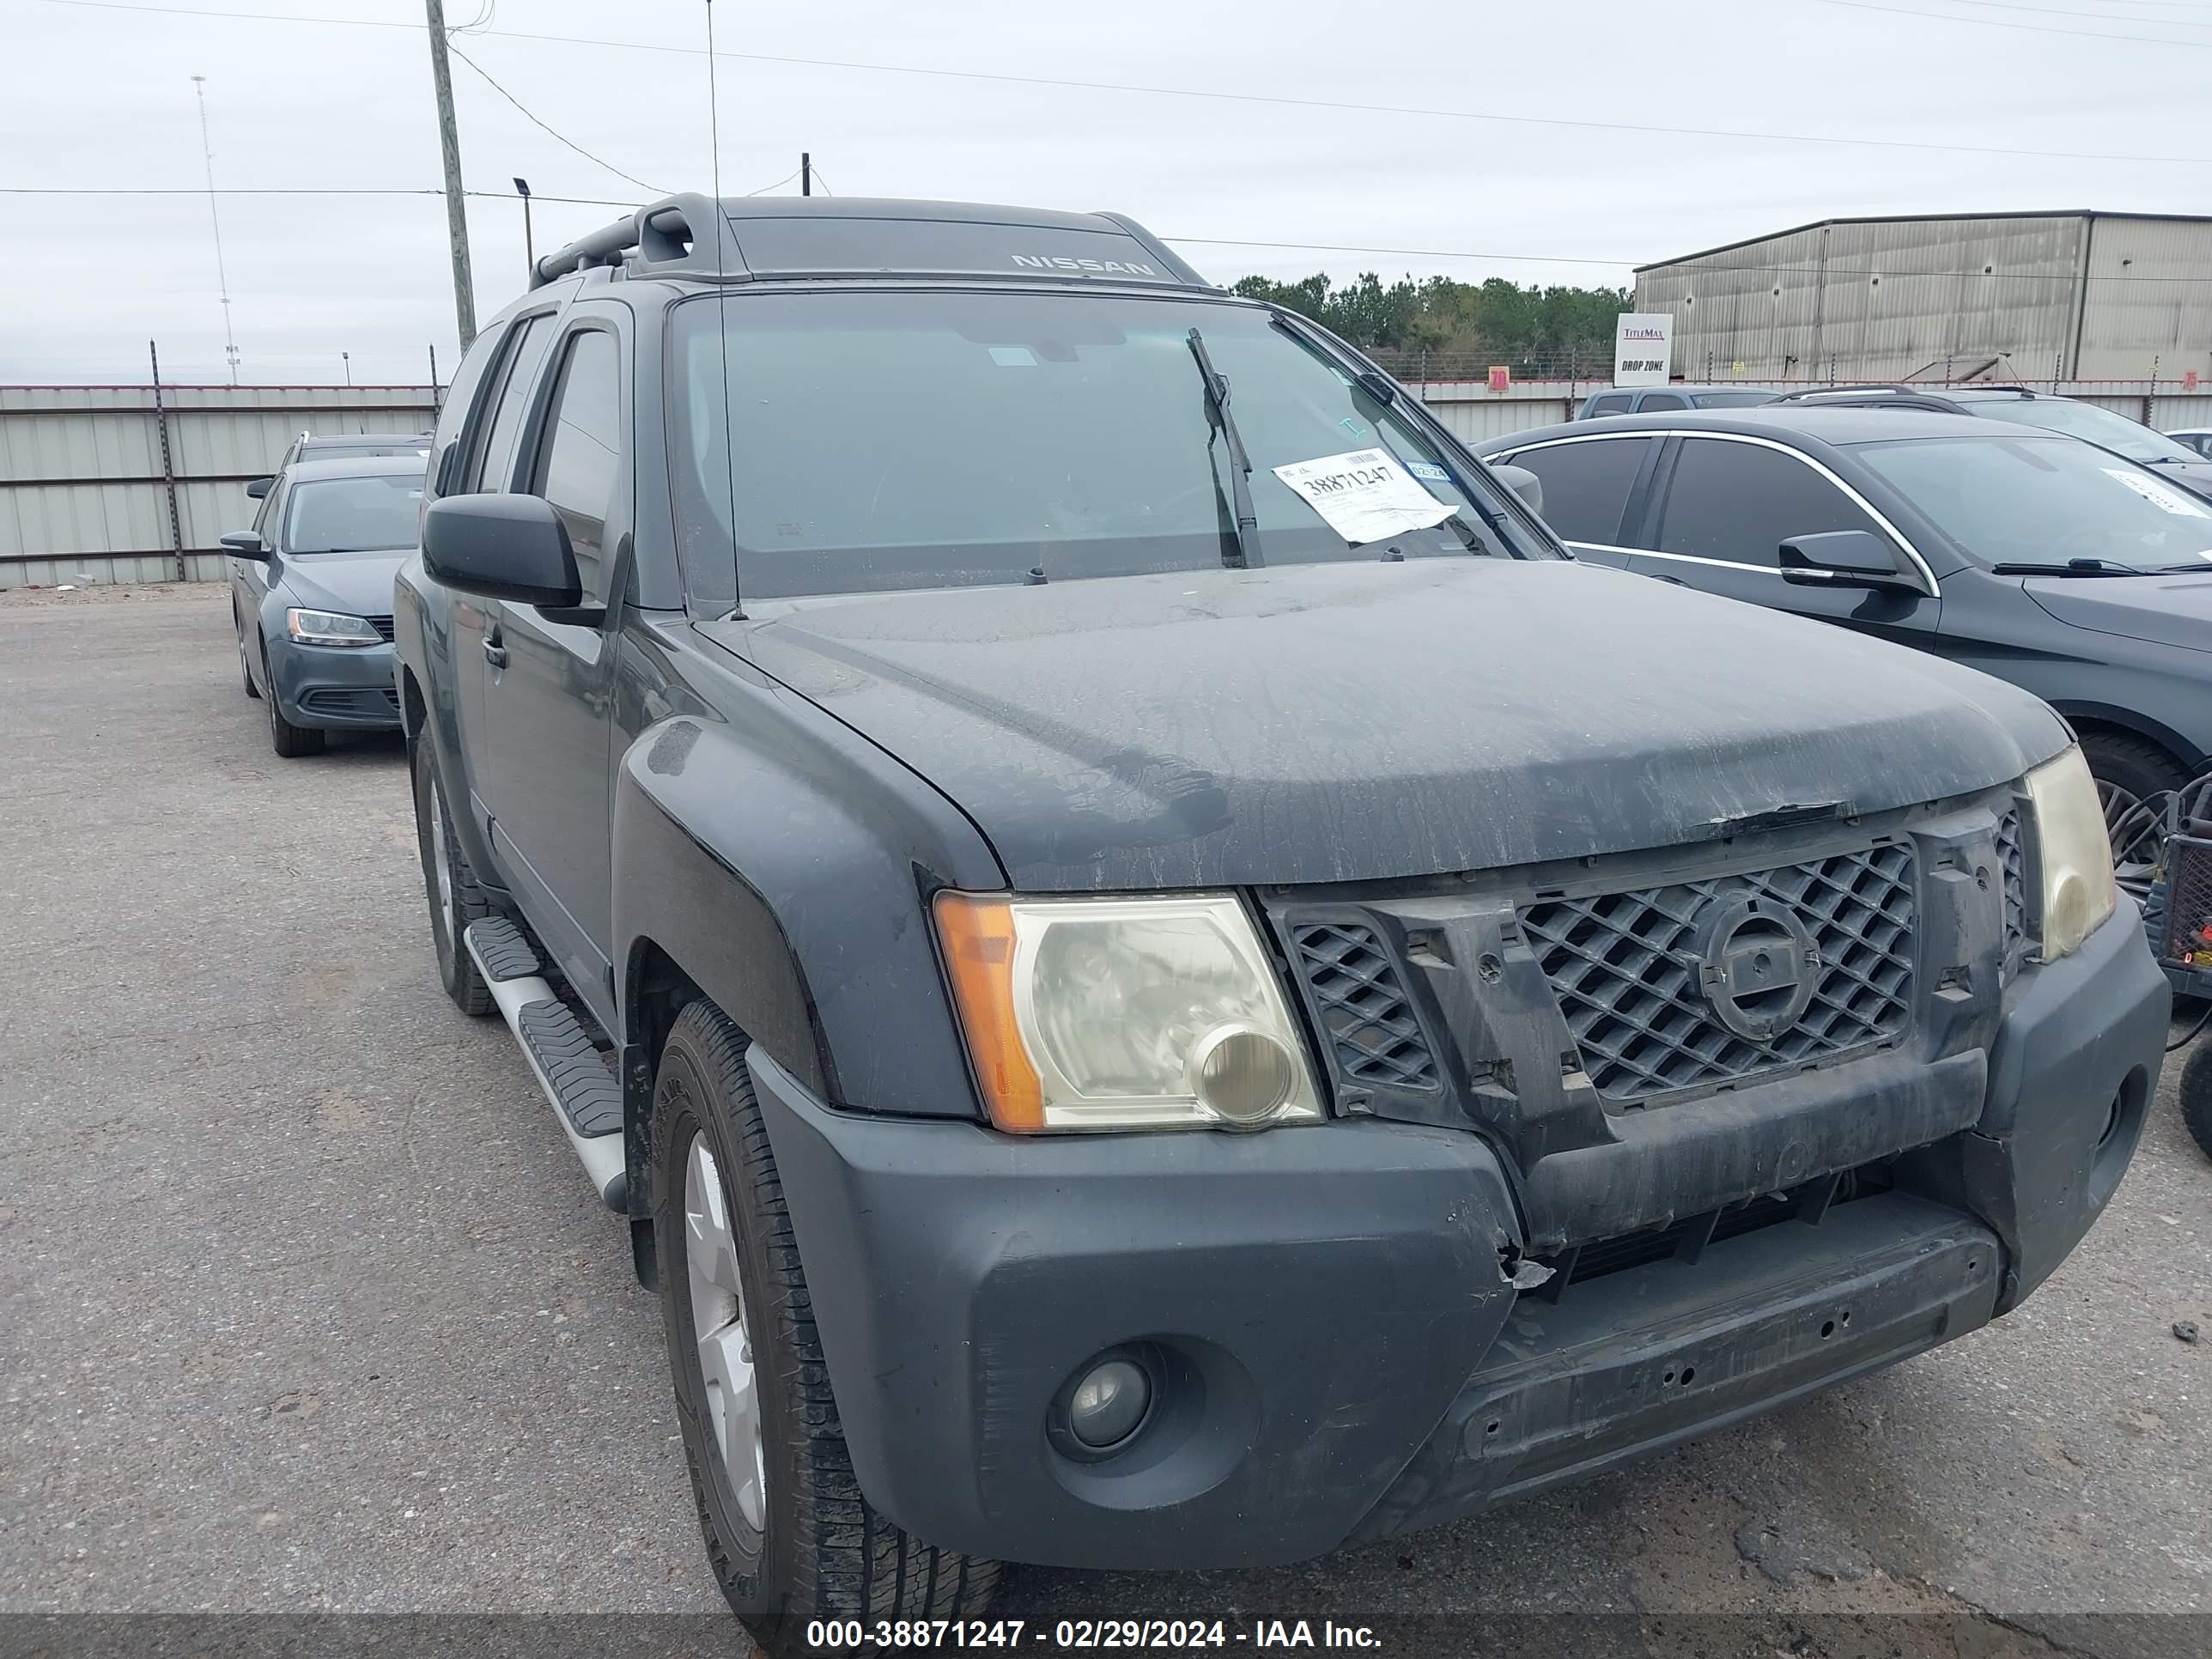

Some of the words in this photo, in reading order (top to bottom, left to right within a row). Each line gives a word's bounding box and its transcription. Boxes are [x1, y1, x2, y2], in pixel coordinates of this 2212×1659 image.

[1011, 254, 1156, 276] NISSAN
[1621, 360, 1644, 372] DROP
[1644, 360, 1664, 372] ZONE
[1304, 466, 1394, 496] 38871247
